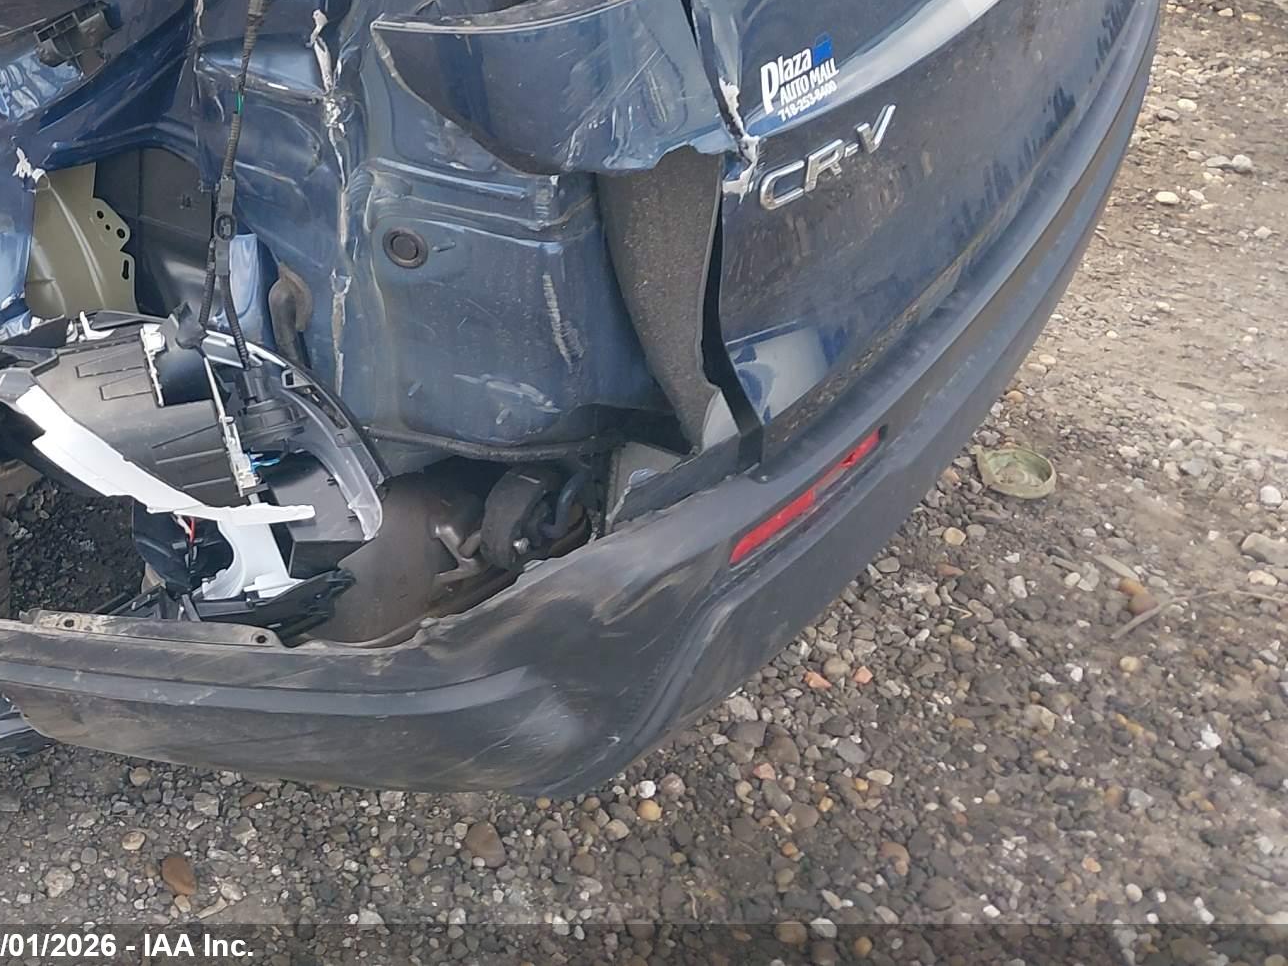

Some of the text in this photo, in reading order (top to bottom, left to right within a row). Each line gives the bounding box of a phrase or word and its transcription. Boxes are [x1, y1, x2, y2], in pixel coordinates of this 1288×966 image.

[760, 48, 813, 114] Plaza
[780, 58, 840, 107] AUTO MALL
[759, 104, 897, 211] CR-V
